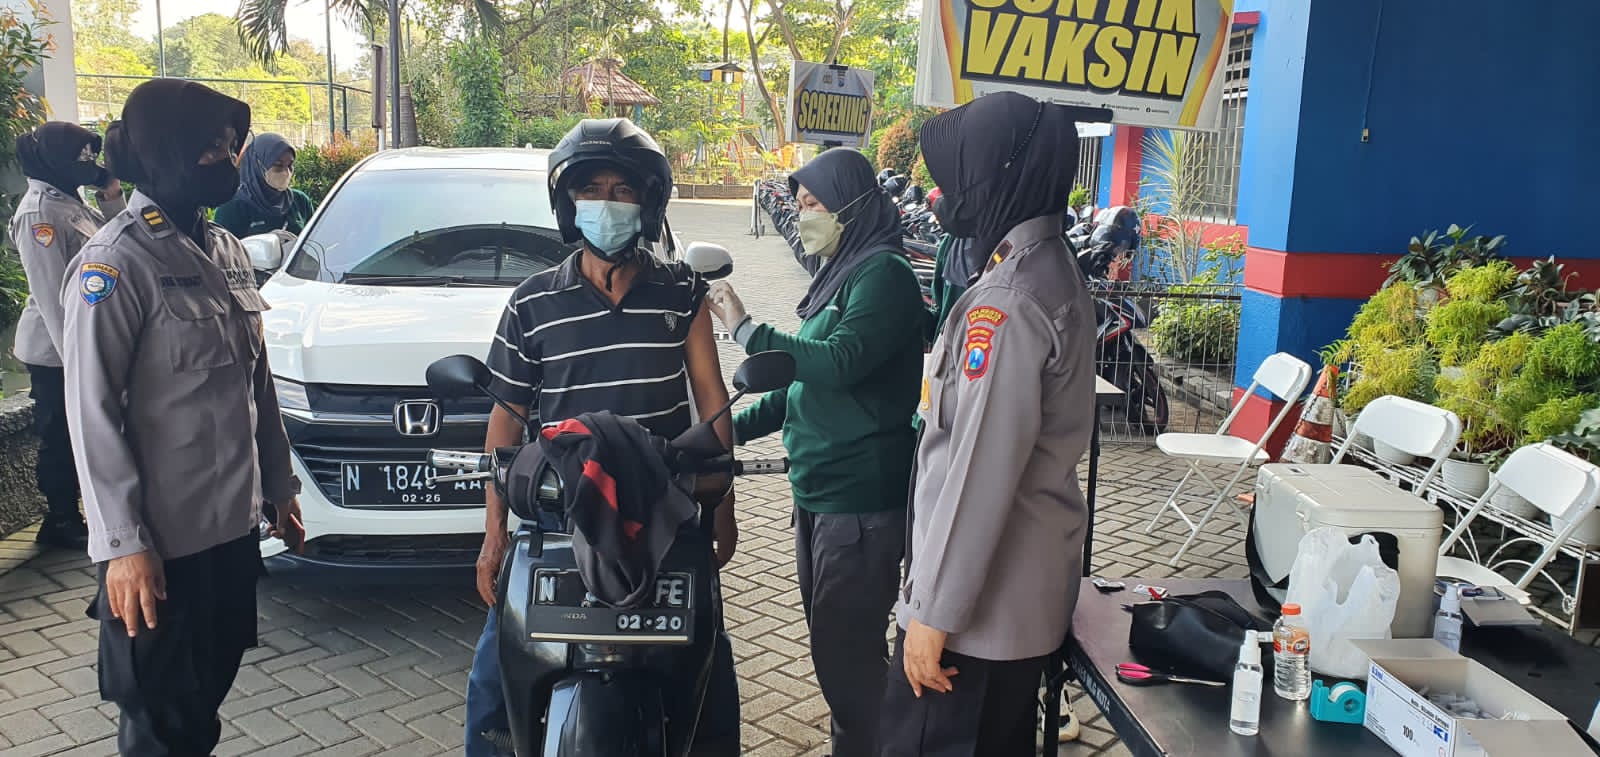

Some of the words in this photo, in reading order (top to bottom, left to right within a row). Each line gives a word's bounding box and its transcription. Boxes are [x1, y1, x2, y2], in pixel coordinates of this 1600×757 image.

[965, 10, 1199, 98] VAKSIN
[798, 91, 868, 134] SCREENING
[346, 465, 360, 491] N
[454, 468, 487, 491] AA
[538, 576, 556, 602] N
